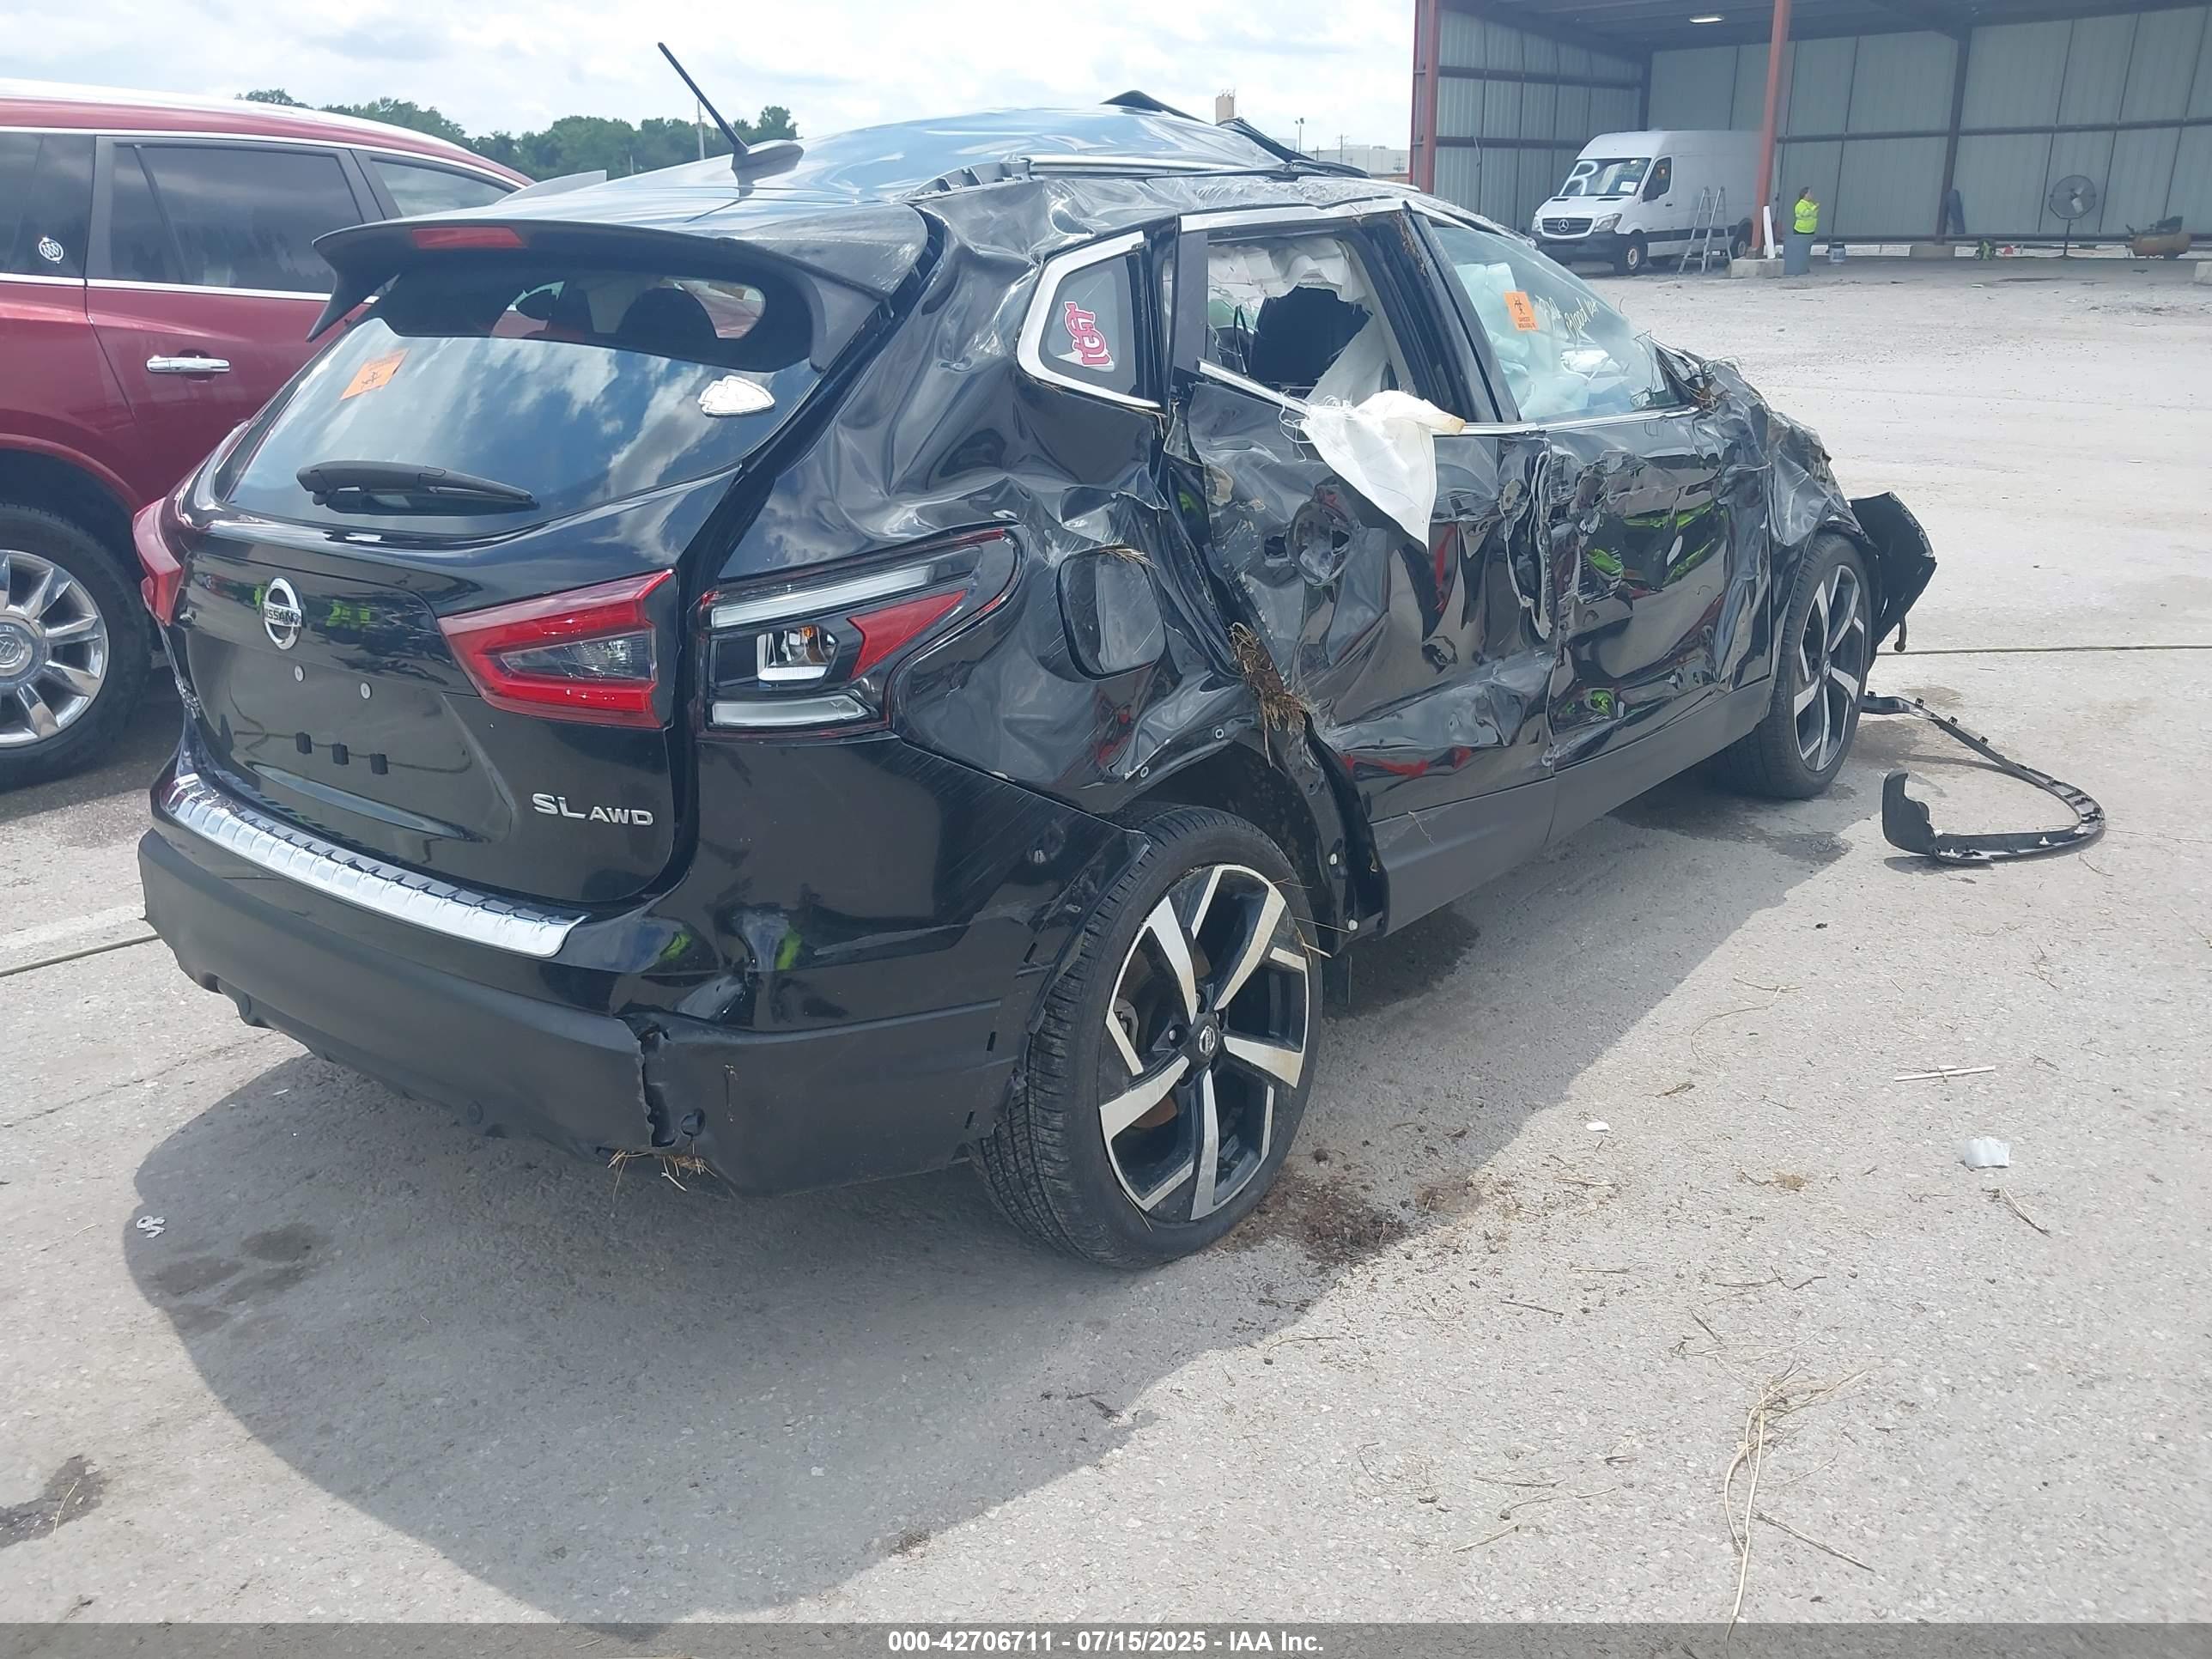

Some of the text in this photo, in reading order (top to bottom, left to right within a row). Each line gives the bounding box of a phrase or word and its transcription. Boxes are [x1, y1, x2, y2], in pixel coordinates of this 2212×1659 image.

[1558, 161, 1599, 197] R
[532, 793, 653, 826] SL AWD
